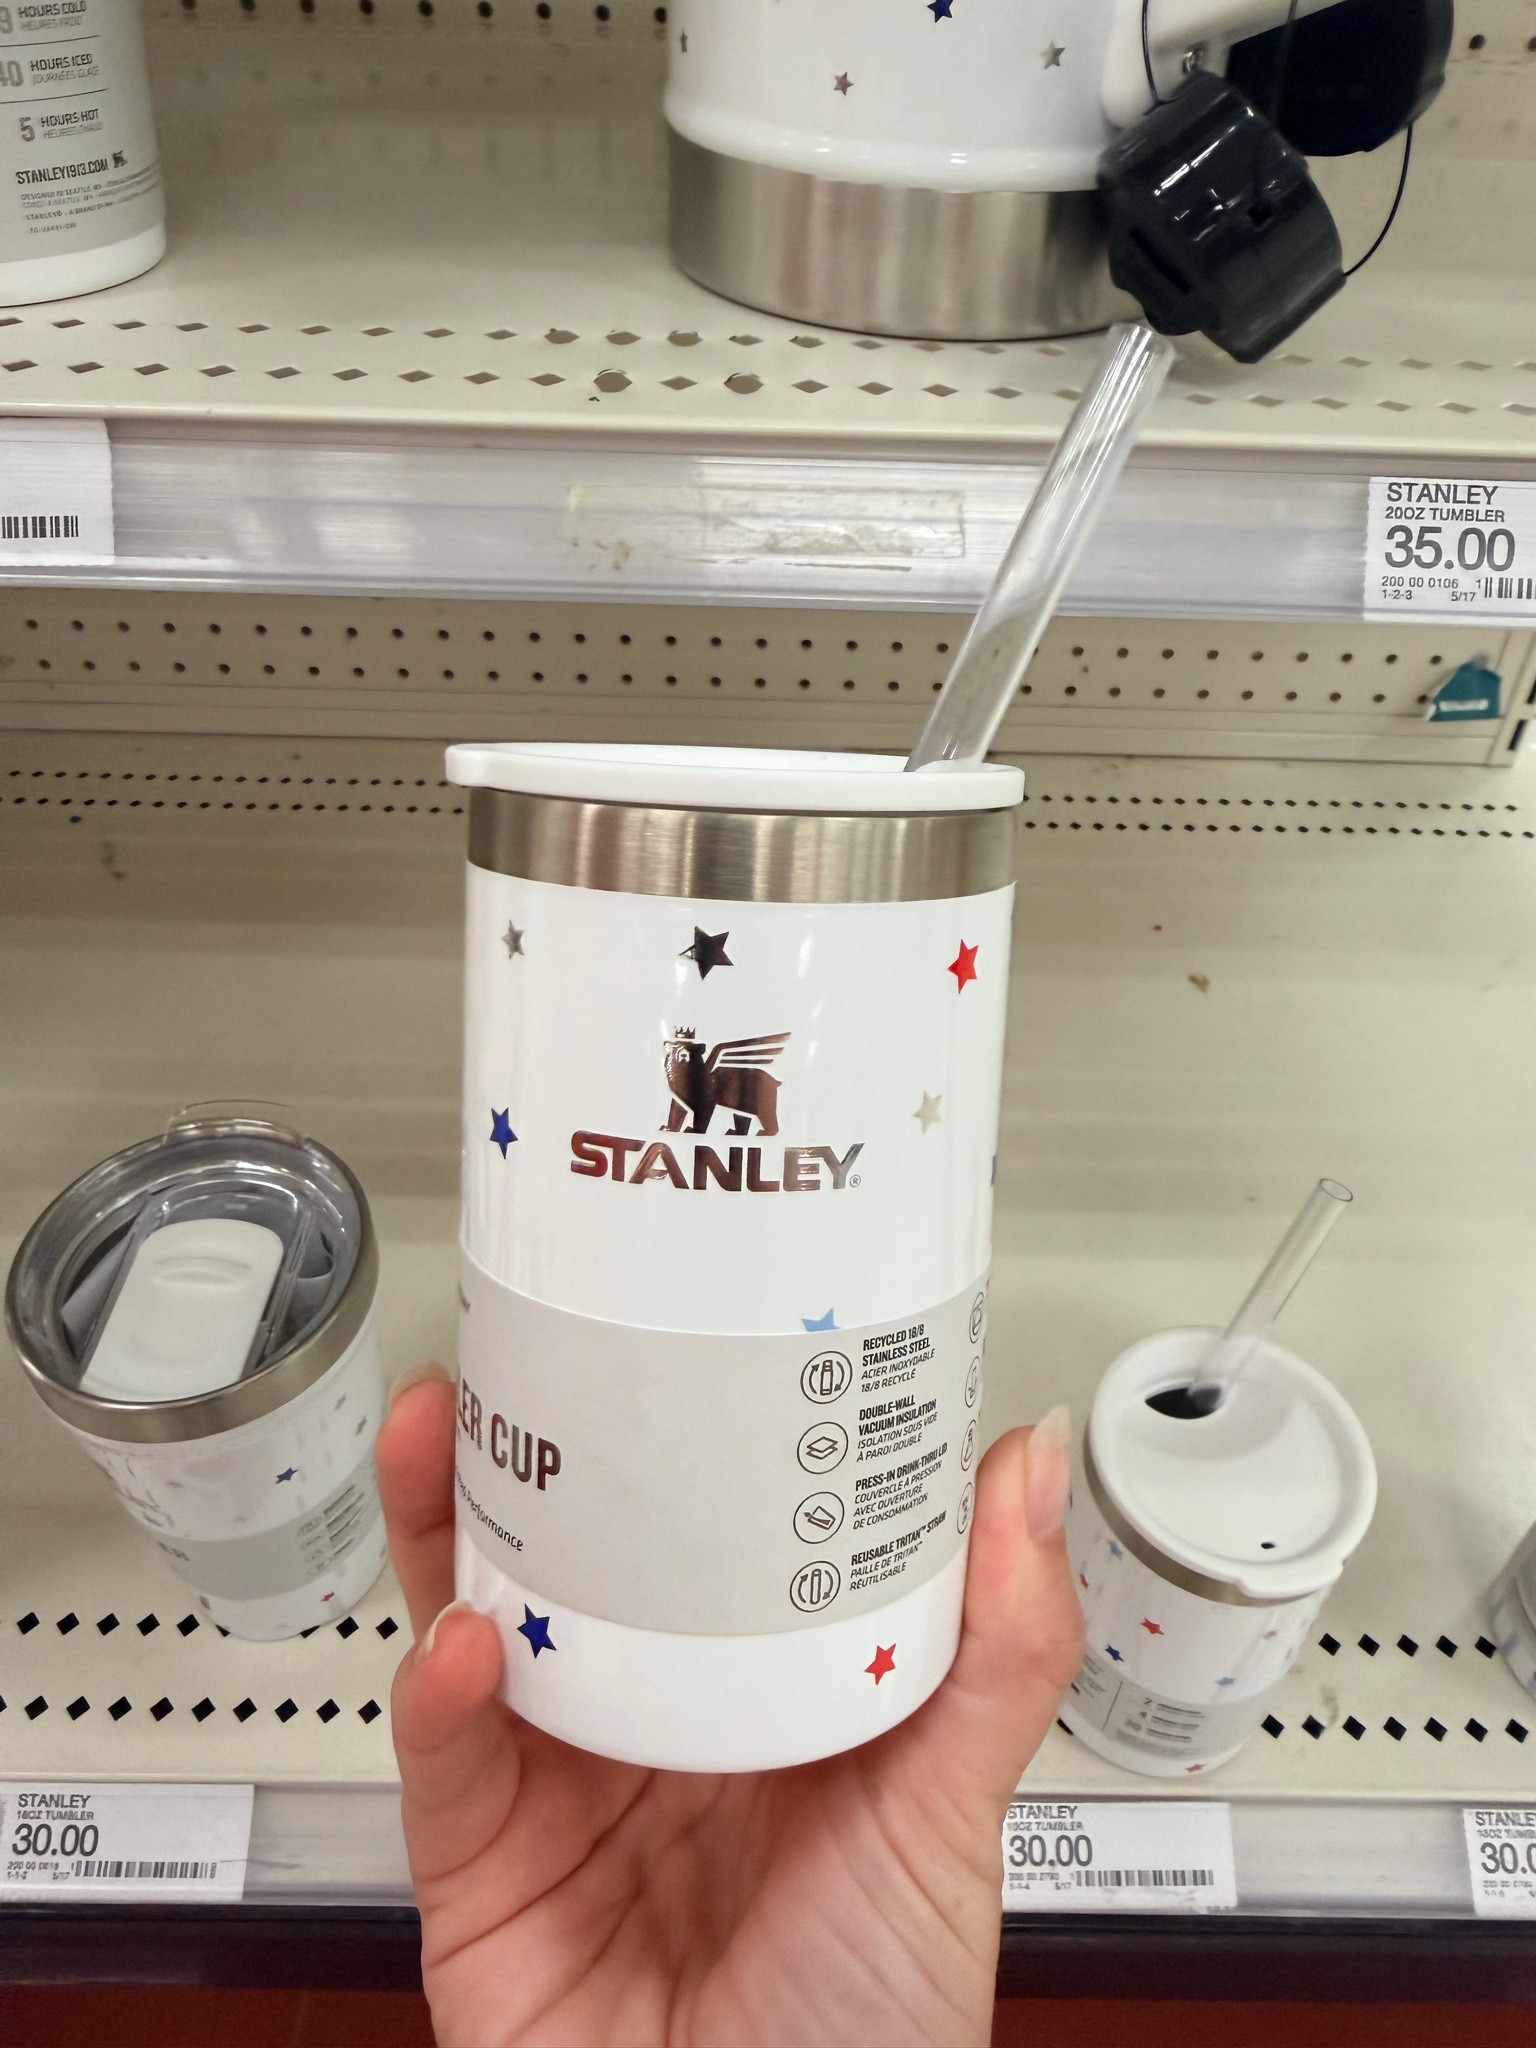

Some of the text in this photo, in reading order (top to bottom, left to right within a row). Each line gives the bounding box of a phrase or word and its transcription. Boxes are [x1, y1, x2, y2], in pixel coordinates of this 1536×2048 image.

[18, 3, 60, 18] HOURS
[30, 53, 93, 71] HOURS ICED
[20, 116, 35, 142] 5
[40, 108, 99, 127] HOURS HOT
[15, 158, 109, 185] STANLEY1913.COM
[1387, 482, 1499, 505] STANLEY
[1385, 506, 1505, 523] 20OZ TUMBLER
[1384, 524, 1516, 571] 35.00
[1381, 576, 1405, 588] 200
[1408, 577, 1424, 588] 00
[1428, 577, 1459, 589] 0106
[1381, 589, 1477, 602] 1-2-3 5/17
[862, 1323, 925, 1352] RECYCLED 18/8
[861, 1348, 935, 1380] ACIER INOXYDABLE
[862, 1336, 931, 1367] STAINLESS STEEL
[861, 1380, 880, 1393] 18/8
[858, 1398, 937, 1436] VACUUM INSULATION
[859, 1394, 916, 1421] DOUBLE-WALL
[857, 1429, 903, 1449] ISOLATION
[902, 1419, 923, 1436] SOUS
[865, 1444, 892, 1460] PAROI
[892, 1432, 922, 1452] DOUBLE
[491, 1412, 562, 1492] CUP
[855, 1442, 948, 1492] PRESS-IN DRINK-THRU LID
[853, 1483, 923, 1517] AVEC OUVERTURE
[854, 1480, 904, 1504] COUVERCLE
[853, 1492, 929, 1530] DE CONSOMMATION
[851, 1541, 895, 1566] REUSABLE
[925, 1510, 947, 1534] STRAW
[850, 1561, 880, 1579] PAILLE
[880, 1556, 893, 1569] DE
[18, 1793, 91, 1808] STANLEY
[1007, 1804, 1078, 1820] STANLEY
[45, 1810, 95, 1821] TUMBLER
[1035, 1821, 1084, 1832] TUMBLER
[12, 1823, 99, 1857] 30.00
[1008, 1834, 1093, 1867] 30.00
